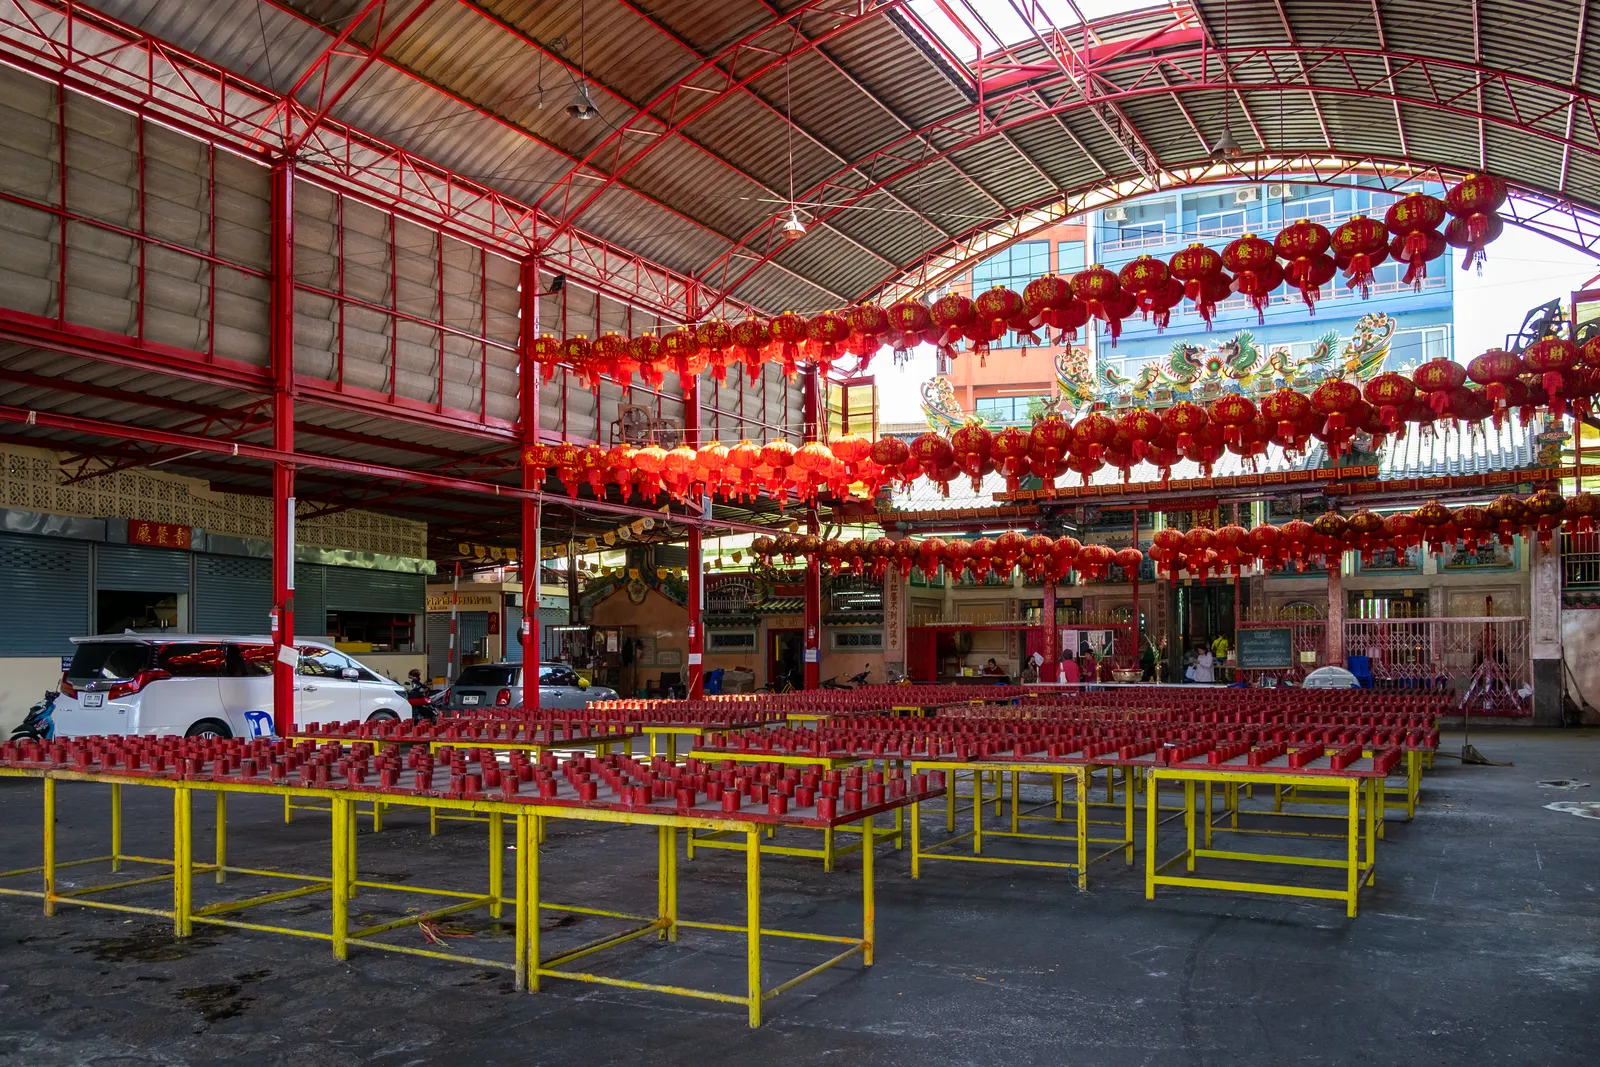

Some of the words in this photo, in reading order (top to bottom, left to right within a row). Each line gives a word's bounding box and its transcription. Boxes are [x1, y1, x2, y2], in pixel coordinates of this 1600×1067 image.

[1460, 186, 1476, 201] 財
[1341, 225, 1355, 243] 發
[1236, 244, 1252, 259] 發
[1174, 254, 1187, 270] 發
[1200, 255, 1213, 269] 財
[1134, 264, 1148, 279] 恭
[1090, 275, 1104, 289] 財
[902, 309, 914, 321] 財
[716, 324, 728, 338] 恭
[824, 318, 836, 332] 恭
[667, 336, 678, 349] 財
[1549, 344, 1563, 361] 財
[1427, 367, 1443, 383] 財
[1379, 382, 1393, 397] 財
[1229, 403, 1241, 418] 財
[921, 439, 933, 454] 財
